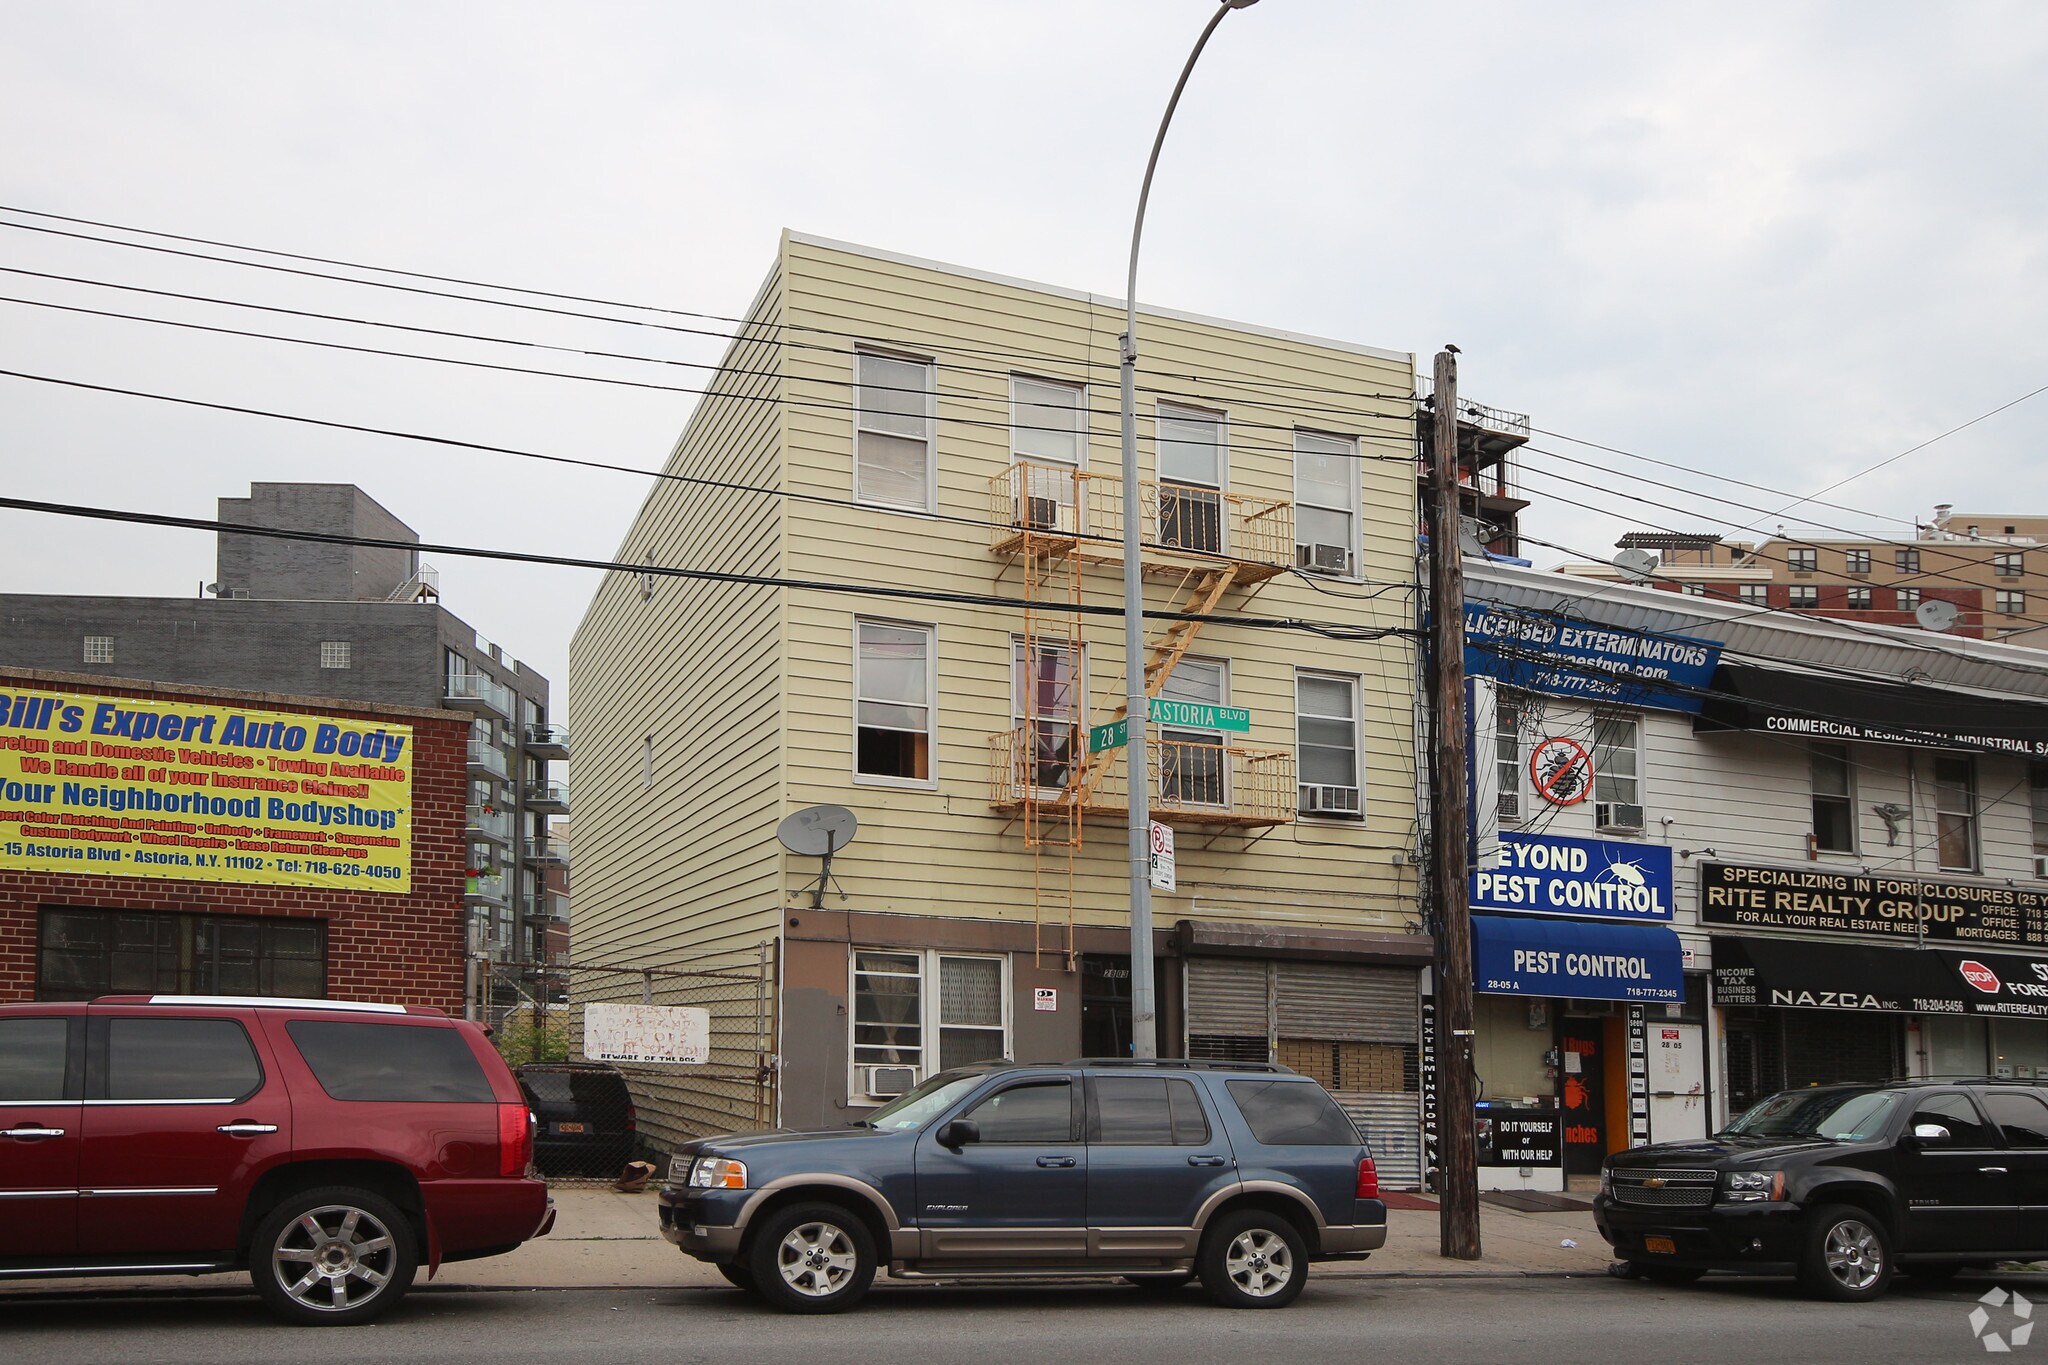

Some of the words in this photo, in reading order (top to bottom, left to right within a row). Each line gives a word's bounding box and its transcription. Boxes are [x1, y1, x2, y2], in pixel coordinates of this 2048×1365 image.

[1464, 613, 1557, 643] LICENSED
[1560, 627, 1708, 667] EXTERMINATORS
[1152, 702, 1215, 726] ASTORIA
[1220, 709, 1247, 721] BLVD
[90, 703, 217, 742] Expert
[219, 715, 307, 752] Auto
[312, 723, 406, 763] Body
[1101, 727, 1114, 748] 28
[1119, 723, 1127, 734] ST
[1766, 716, 1861, 737] COMMERCIAL
[1864, 728, 1949, 748] RESITIAL
[1954, 735, 2033, 753] INDUSTRIAL
[52, 740, 87, 756] and
[91, 741, 175, 762] Domestic
[178, 748, 254, 769] Vehicles
[267, 756, 328, 777] Towing
[330, 761, 406, 782] Available
[20, 757, 51, 774] We
[54, 759, 119, 779] Handle
[121, 765, 145, 781] all
[148, 767, 167, 783] of
[169, 770, 209, 785] your
[211, 772, 299, 793] Insurance
[301, 779, 369, 799] Claims!!
[62, 782, 261, 818] Neighborhood
[25, 811, 60, 824] Color
[61, 813, 120, 829] Matching
[120, 817, 145, 830] And
[146, 819, 196, 834] Painting
[204, 823, 253, 838] Unibody
[264, 827, 327, 842] Framework
[335, 832, 401, 848] Suspension
[21, 825, 70, 839] Custom
[70, 828, 132, 843] Bodywork
[140, 833, 180, 846] Wheel
[180, 835, 227, 849] Repairs
[235, 839, 270, 852] Lease
[270, 842, 310, 855] Return
[311, 844, 368, 859] Clean-ups
[26, 843, 84, 860] Astoria
[87, 847, 121, 862] Blvd
[134, 850, 192, 867] Astoria,
[195, 853, 221, 868] N.Y.
[224, 856, 264, 871] 11102
[276, 859, 302, 872] Tel:
[304, 861, 401, 879] 718-626-4050
[1498, 841, 1588, 873] EYOND
[1477, 873, 1541, 904] PEST
[1549, 878, 1666, 914] CONTROL
[1723, 868, 1847, 890] SPECIALIZING
[1854, 879, 1871, 892] IN
[1876, 880, 2014, 904] FORECLOSURES
[2017, 892, 2038, 906] (25
[1708, 886, 1767, 909] RITE
[1774, 891, 1872, 915] REALTY
[1878, 900, 1965, 923] GROUP
[1981, 904, 2019, 917] OFFICE:
[2026, 908, 2042, 918] 718
[1736, 911, 1760, 923] FOR
[1762, 913, 1784, 924] ALL
[1786, 915, 1817, 926] YOUR
[1820, 917, 1848, 929] REAL
[1851, 919, 1891, 932] ESTATE
[1893, 922, 1929, 935] NEEDS
[1982, 916, 2020, 929] OFFICE:
[2026, 920, 2042, 930] 718
[1956, 927, 2020, 941] MORTGAGES:
[2026, 932, 2042, 942] 888
[1514, 950, 1560, 974] PEST
[1565, 954, 1651, 980] CONTROL
[1716, 968, 1755, 977] INCOME
[1487, 980, 1511, 990] 28-05
[1513, 982, 1520, 990] A
[1721, 977, 1747, 985] TAX
[1965, 971, 1993, 983] STOP
[1626, 987, 1678, 998] 718-777-2345
[1717, 986, 1756, 994] BUSINESS
[1717, 995, 1757, 1003] MATTERS
[1772, 990, 1882, 1009] NAZCA
[1913, 998, 1964, 1012] 718-204-5456
[1630, 1019, 1643, 1027] seen
[1632, 1028, 1641, 1036] on
[1661, 1041, 1670, 1049] 28
[601, 1053, 639, 1061] BEWARE
[1423, 1018, 1437, 1129] EXTERMINATOR
[1500, 1121, 1510, 1132] DO
[1511, 1121, 1518, 1132] IT
[1519, 1121, 1553, 1133] YOURSELF
[1502, 1149, 1519, 1160] WITH
[1520, 1150, 1535, 1160] OUR
[1536, 1150, 1553, 1160] HELP
